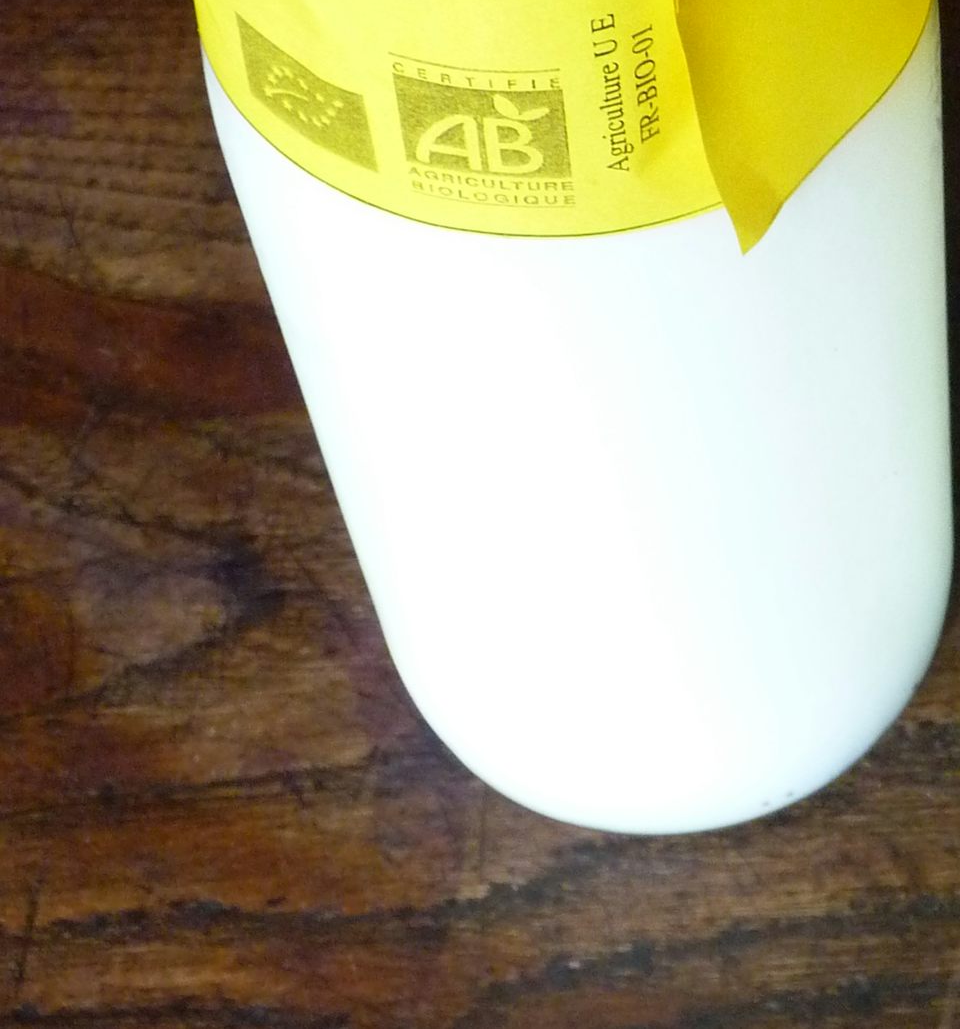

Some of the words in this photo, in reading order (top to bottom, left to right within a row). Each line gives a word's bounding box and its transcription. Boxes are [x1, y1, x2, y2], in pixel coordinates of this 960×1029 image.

[631, 24, 661, 145] FR-BIO-01
[414, 113, 545, 176] AB
[599, 61, 635, 173] Agriculture
[407, 165, 576, 192] AGRICULTURE
[410, 179, 577, 207] BIOLOGIQUE
